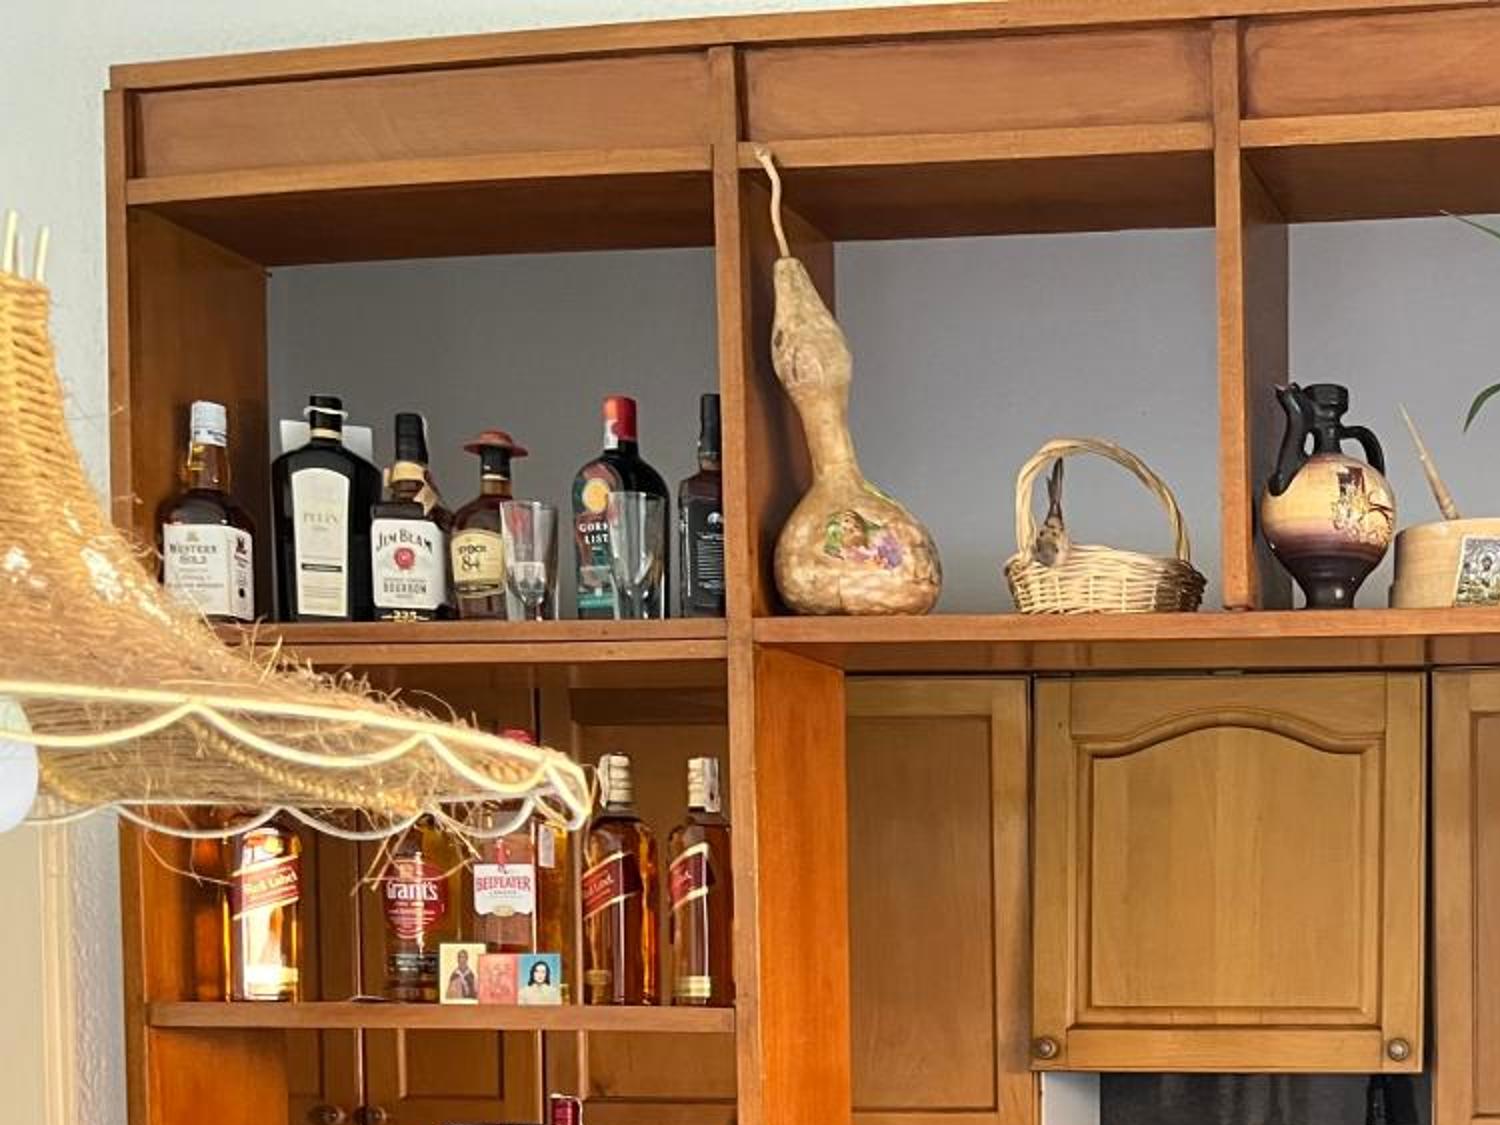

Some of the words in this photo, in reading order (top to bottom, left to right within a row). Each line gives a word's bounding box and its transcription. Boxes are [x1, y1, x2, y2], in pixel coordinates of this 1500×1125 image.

[375, 531, 398, 552] JIM
[399, 528, 434, 554] BEAM
[475, 875, 532, 892] BEEFEATER
